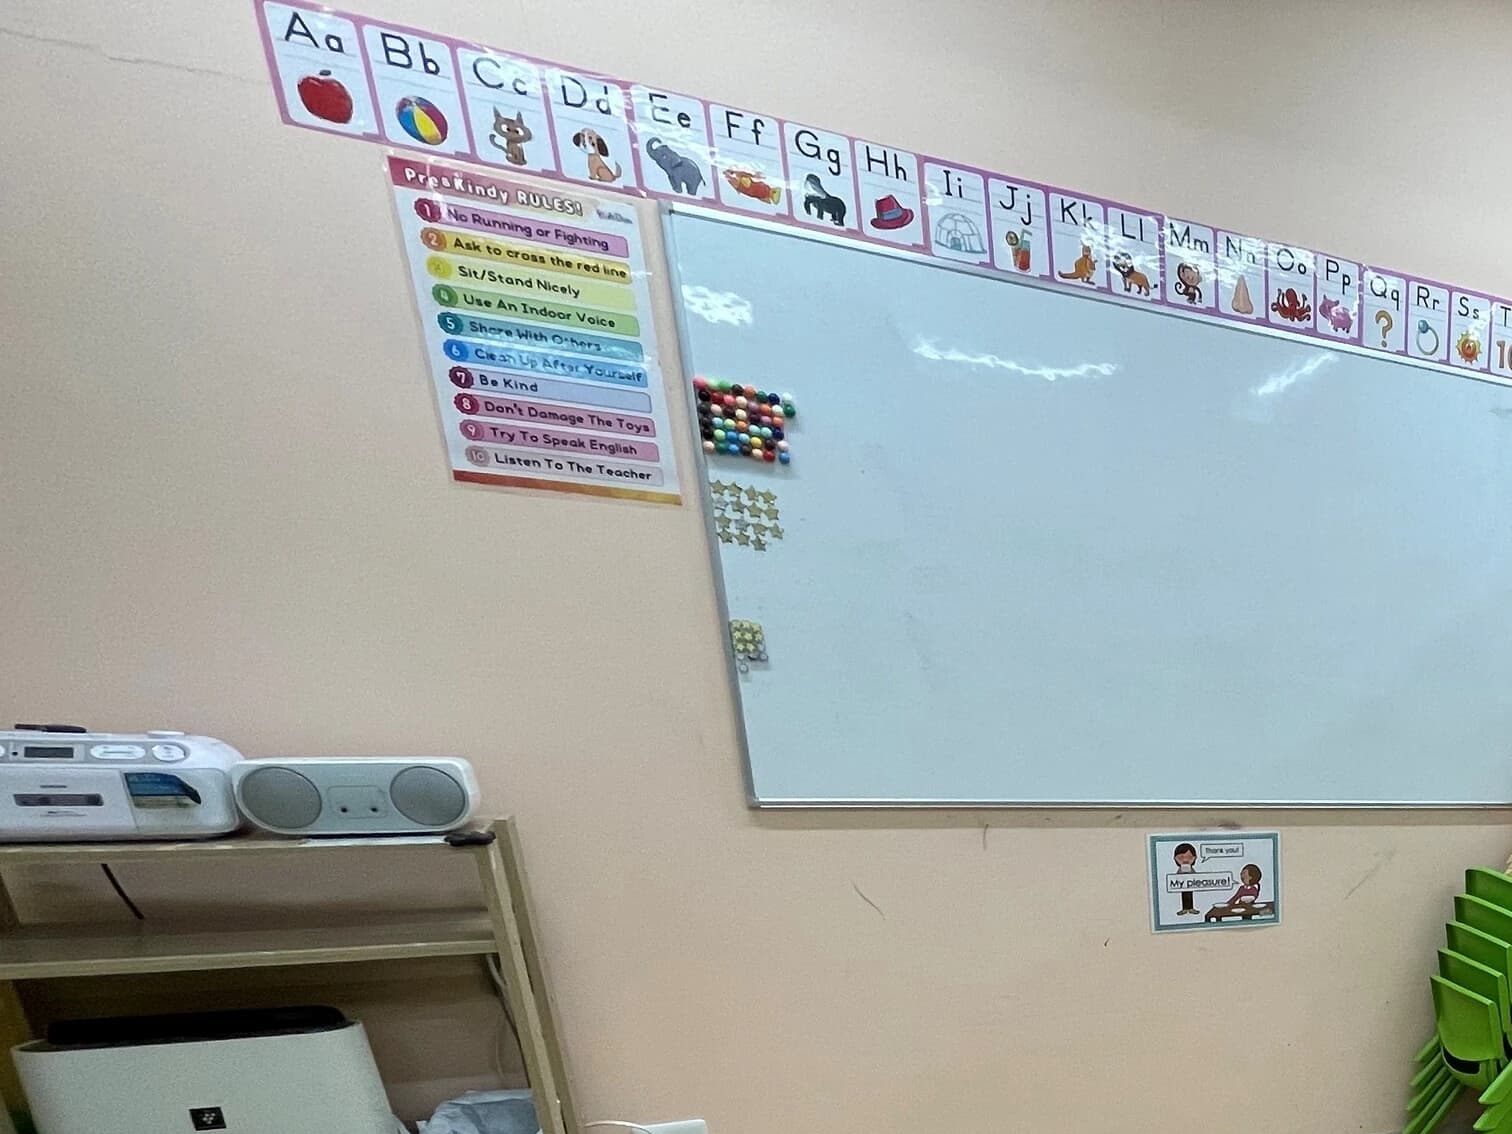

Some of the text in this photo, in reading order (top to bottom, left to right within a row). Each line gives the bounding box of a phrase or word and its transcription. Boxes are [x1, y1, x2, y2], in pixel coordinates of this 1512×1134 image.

[516, 190, 584, 216] RULES!
[424, 204, 431, 217] 1
[447, 208, 468, 223] No
[472, 213, 532, 237] Running
[555, 229, 609, 251] Fighting
[428, 232, 627, 278] 2 Ask to cross the red line
[458, 265, 533, 288] Sit/Stand
[537, 280, 580, 298] Nicely
[440, 290, 615, 328] 4 Use An Indoor Voice
[446, 317, 455, 330] 5
[469, 321, 513, 337] Share
[517, 329, 548, 342] With
[451, 344, 642, 382] 6 Clean Up After Yourself
[456, 371, 538, 392] 7 Be Kind
[462, 397, 650, 434] 8 Don't Damage The Toys
[467, 424, 638, 457] 9 Try To Speak English
[470, 450, 652, 481] 10 Listen To The Teacher
[1170, 877, 1231, 889] My pleasure!
